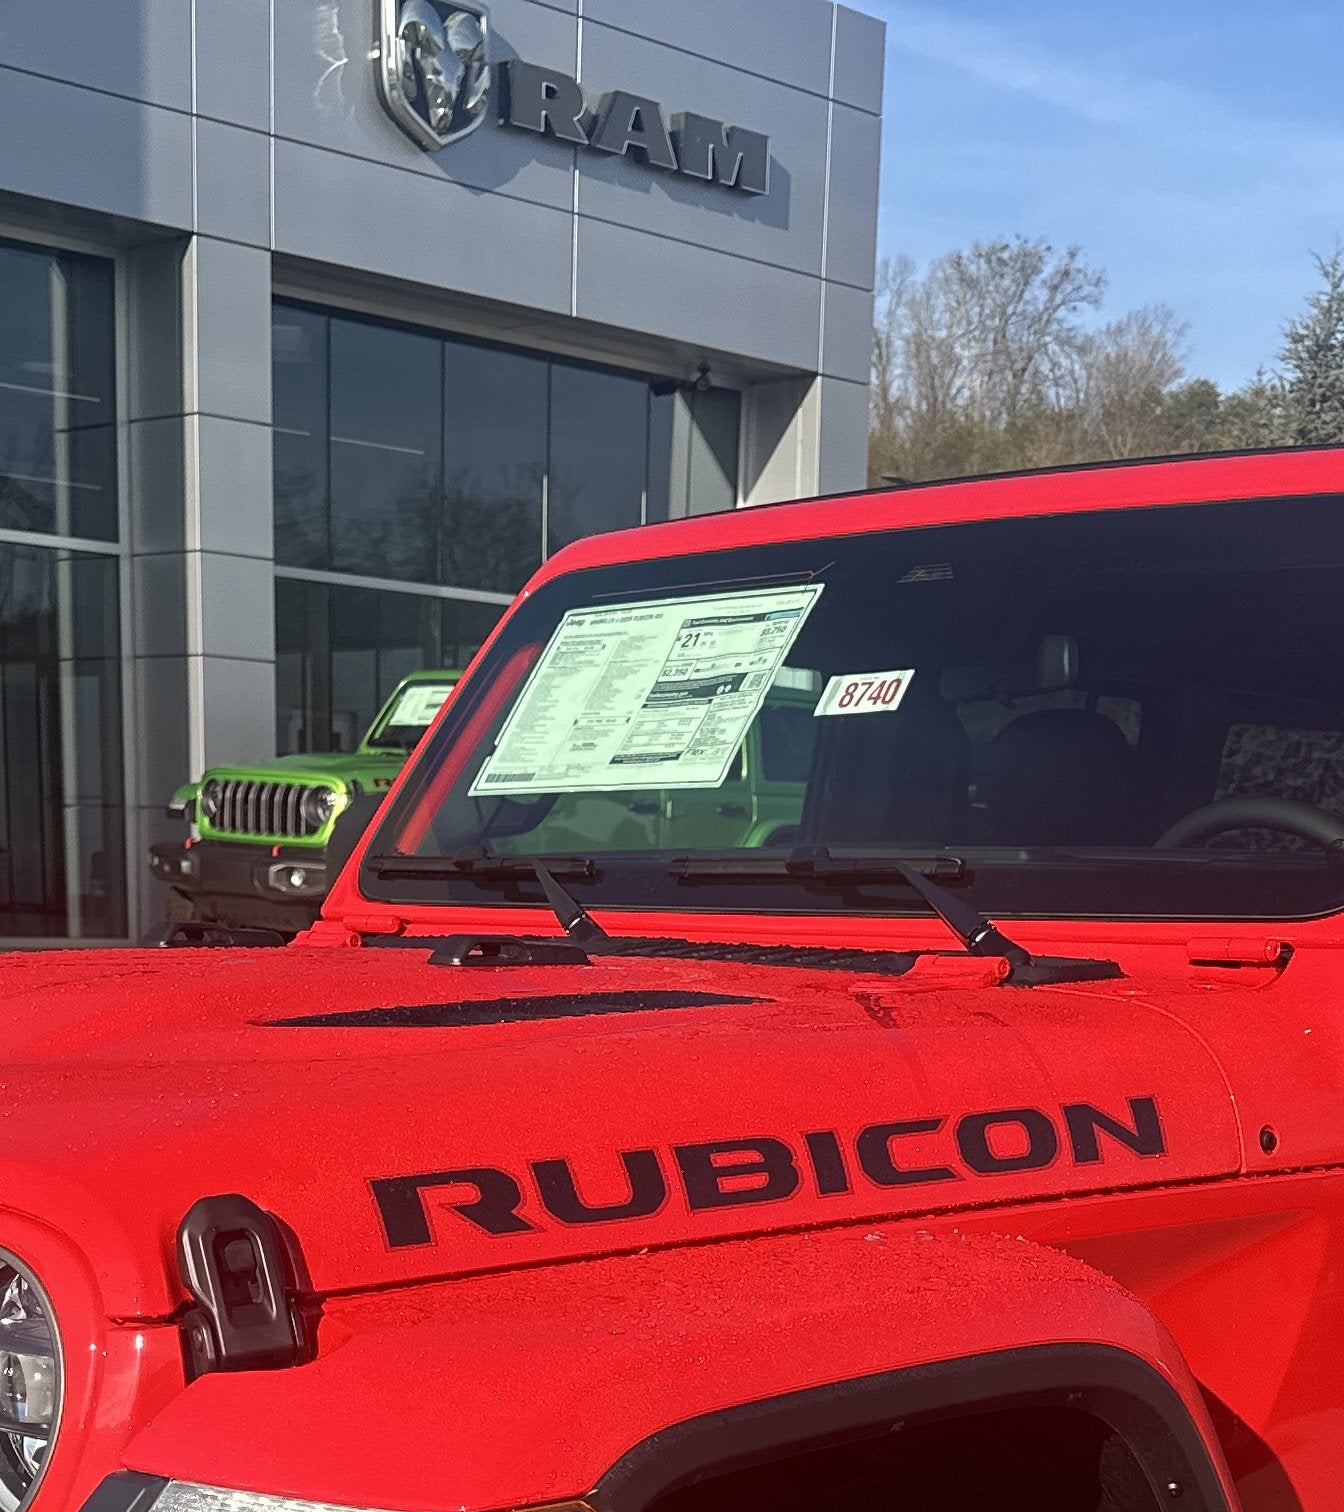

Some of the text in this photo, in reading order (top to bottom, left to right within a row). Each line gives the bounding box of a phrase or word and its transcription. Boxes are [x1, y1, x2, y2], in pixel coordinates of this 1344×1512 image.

[498, 58, 770, 195] RAM
[681, 632, 701, 648] 21
[838, 677, 902, 709] 8740
[368, 1095, 1168, 1253] RUBICON
